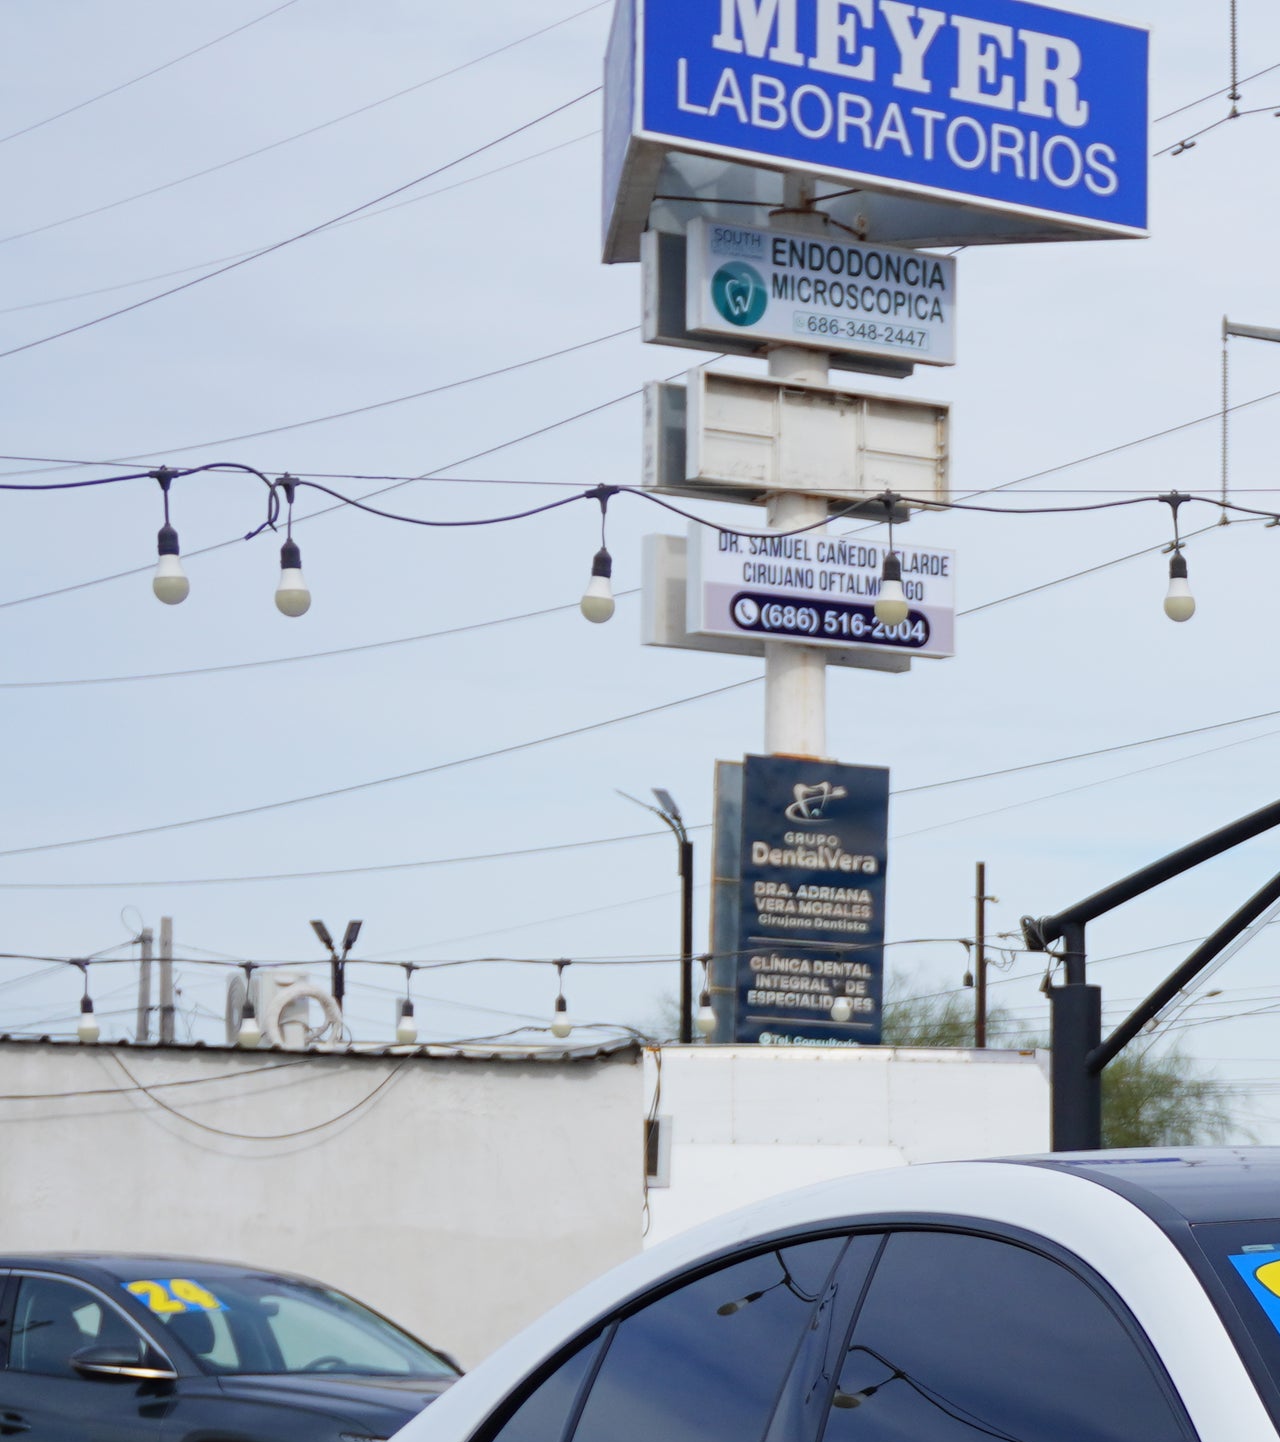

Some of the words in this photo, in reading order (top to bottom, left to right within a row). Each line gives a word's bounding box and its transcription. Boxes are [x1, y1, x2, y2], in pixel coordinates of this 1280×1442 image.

[711, 0, 1089, 128] MEYER
[677, 58, 1118, 196] LABORATORIOS
[771, 237, 946, 291] ENDODONCIA
[771, 272, 945, 323] MICROSCOPICA
[807, 315, 926, 346] 686-348-2447
[718, 531, 744, 555] DR.
[749, 535, 812, 562] SAMUEL
[816, 537, 877, 569] CAÑEDO
[882, 548, 950, 577] LARDE
[742, 562, 815, 590] CIRUJANO
[818, 570, 925, 602] OFTALMGO
[761, 603, 819, 634] (686)
[783, 831, 839, 848] GRUPO
[751, 840, 878, 874] DentalVera
[753, 881, 793, 898] DRA.
[795, 884, 872, 903] ADRIANA
[755, 897, 797, 914] VERA
[797, 901, 872, 919] MORALES
[813, 917, 868, 932] Dentista
[750, 953, 811, 975] CLÍNICA
[813, 960, 872, 978] DENTAL
[755, 974, 830, 992] INTEGRAL
[844, 980, 867, 995] DE
[126, 1278, 222, 1315] 24
